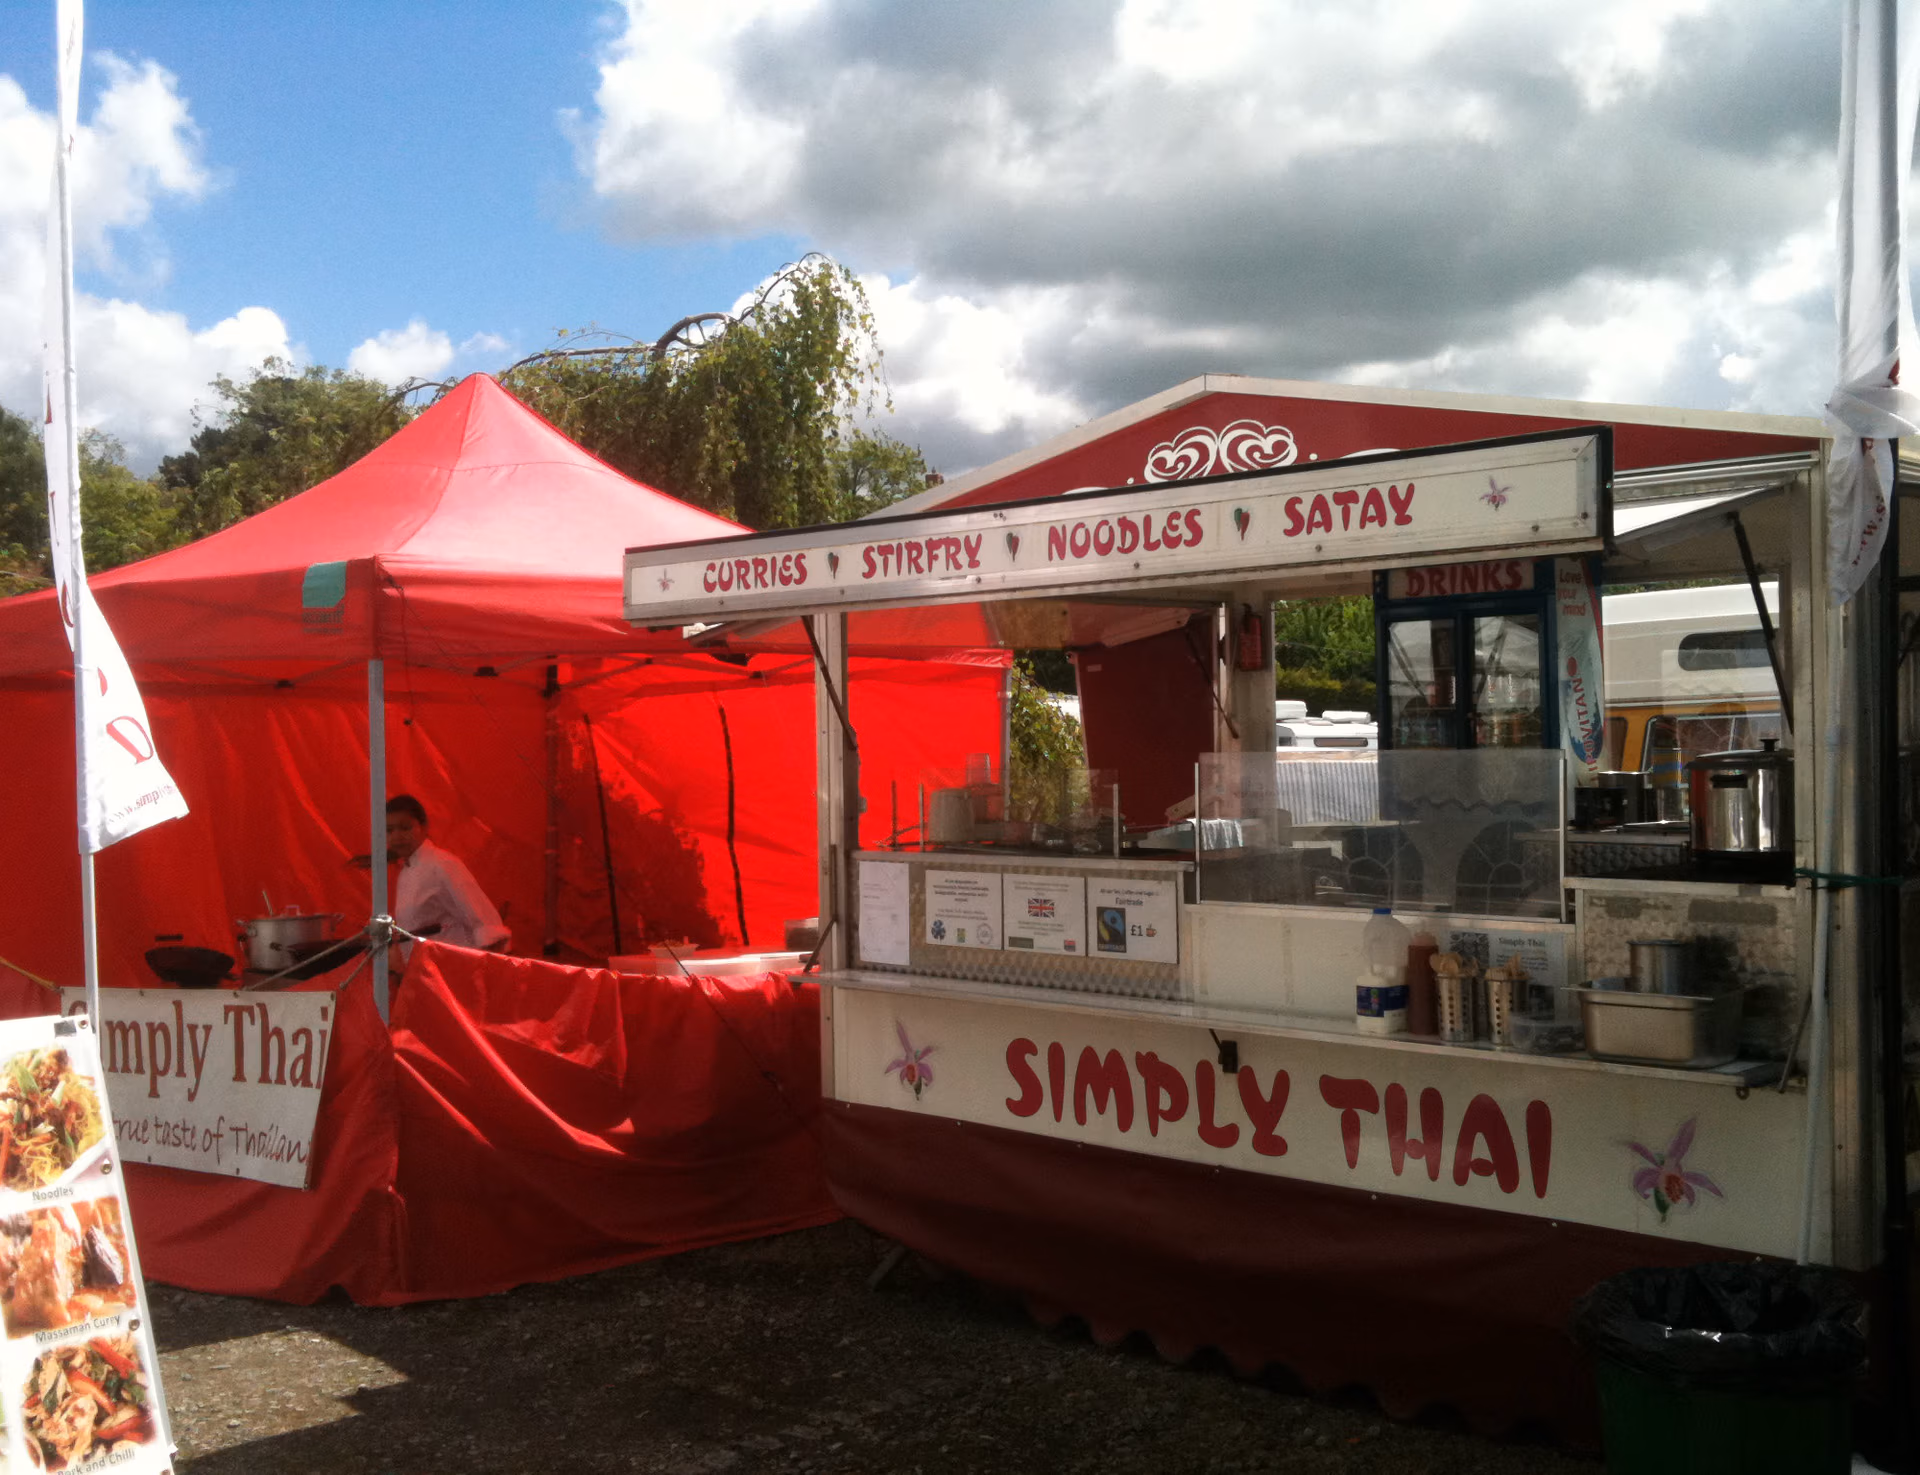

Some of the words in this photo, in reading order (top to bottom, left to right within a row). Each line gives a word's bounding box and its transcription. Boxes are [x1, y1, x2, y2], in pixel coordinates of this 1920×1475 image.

[703, 553, 808, 593] CURRIES
[861, 533, 983, 579] STIRFRY
[1047, 508, 1204, 562] NOODLES
[1283, 482, 1416, 538] SATAY
[1405, 560, 1523, 598] DRINKS
[223, 1002, 329, 1090] Thai
[153, 1116, 197, 1152] taste
[202, 1115, 225, 1165] of
[229, 1122, 310, 1164] Thailan
[1005, 1037, 1291, 1157] SIMPLY
[1319, 1073, 1553, 1199] THAI
[32, 1186, 74, 1201] Noodles
[35, 1322, 91, 1343] Massaman
[86, 1456, 106, 1473] and
[108, 1448, 136, 1464] Chilli
